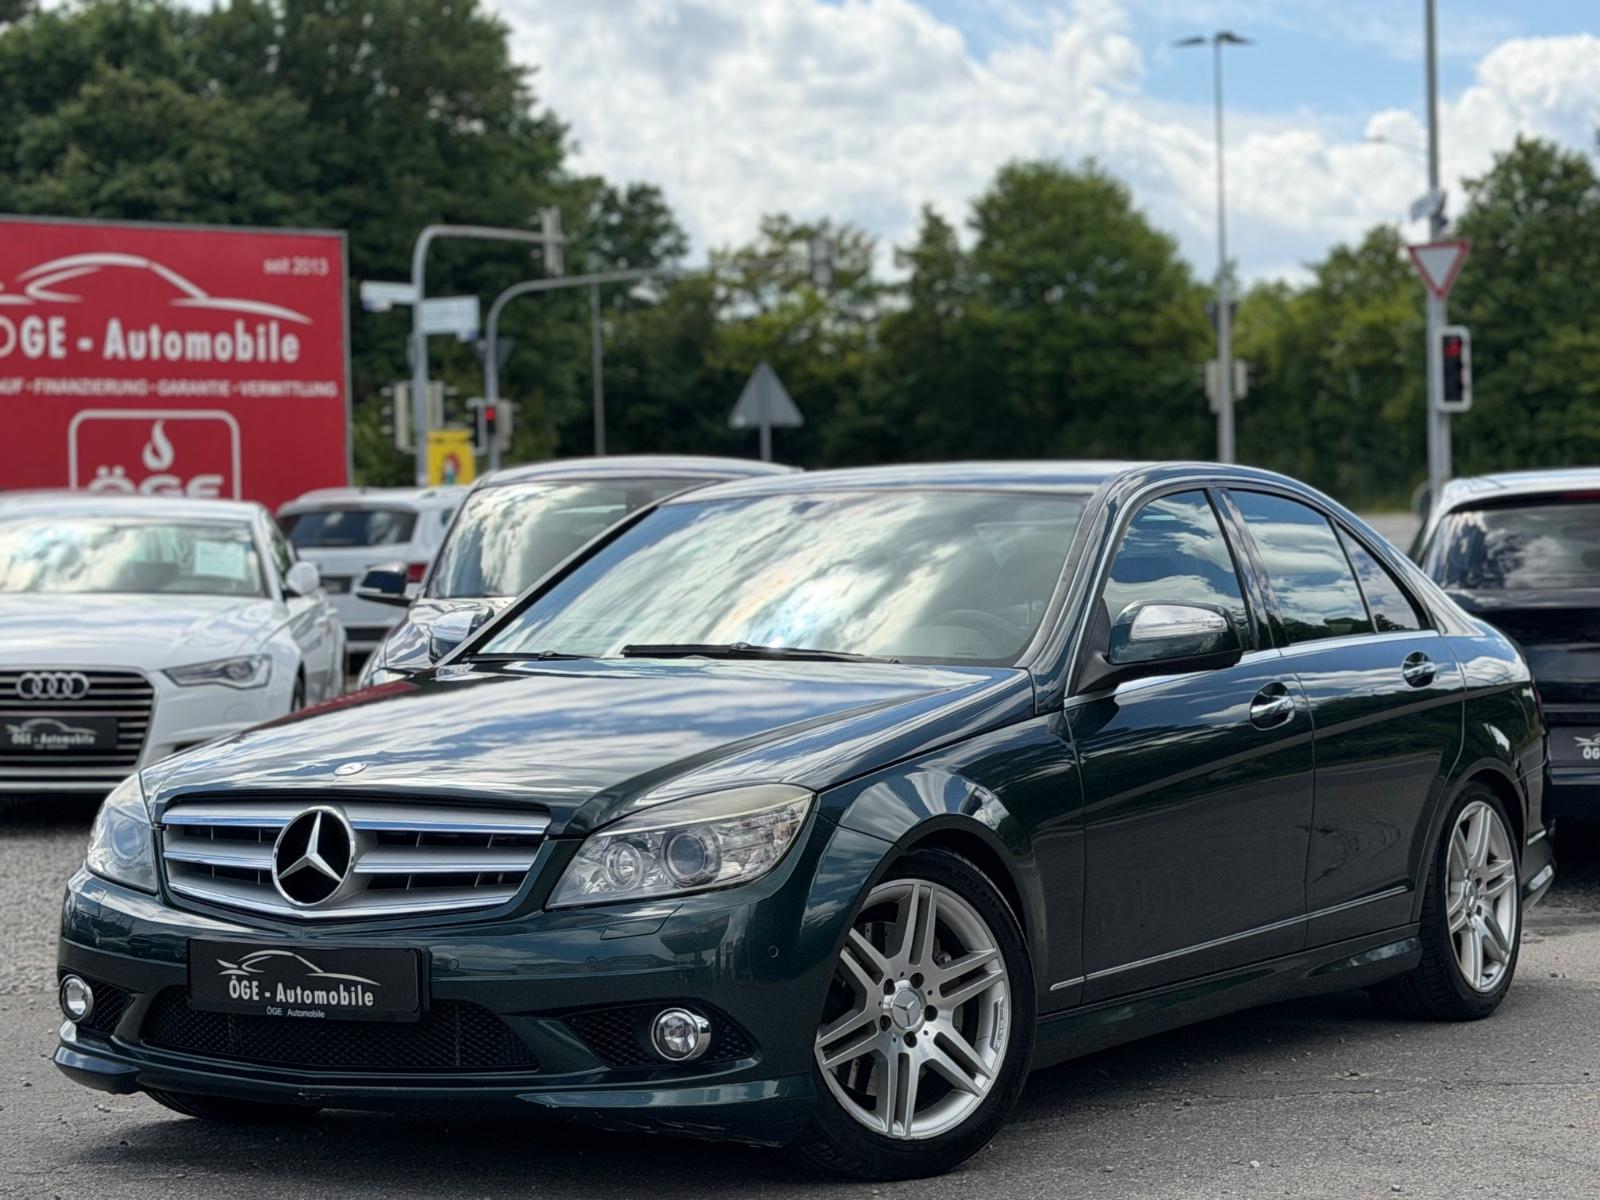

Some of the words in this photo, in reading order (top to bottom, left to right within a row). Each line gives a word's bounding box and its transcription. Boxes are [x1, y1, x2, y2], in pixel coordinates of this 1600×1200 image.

[102, 317, 301, 363] Automobile
[229, 975, 259, 1000] ÖGE
[276, 982, 374, 1006] Automobile
[287, 1008, 326, 1018] Automobile
